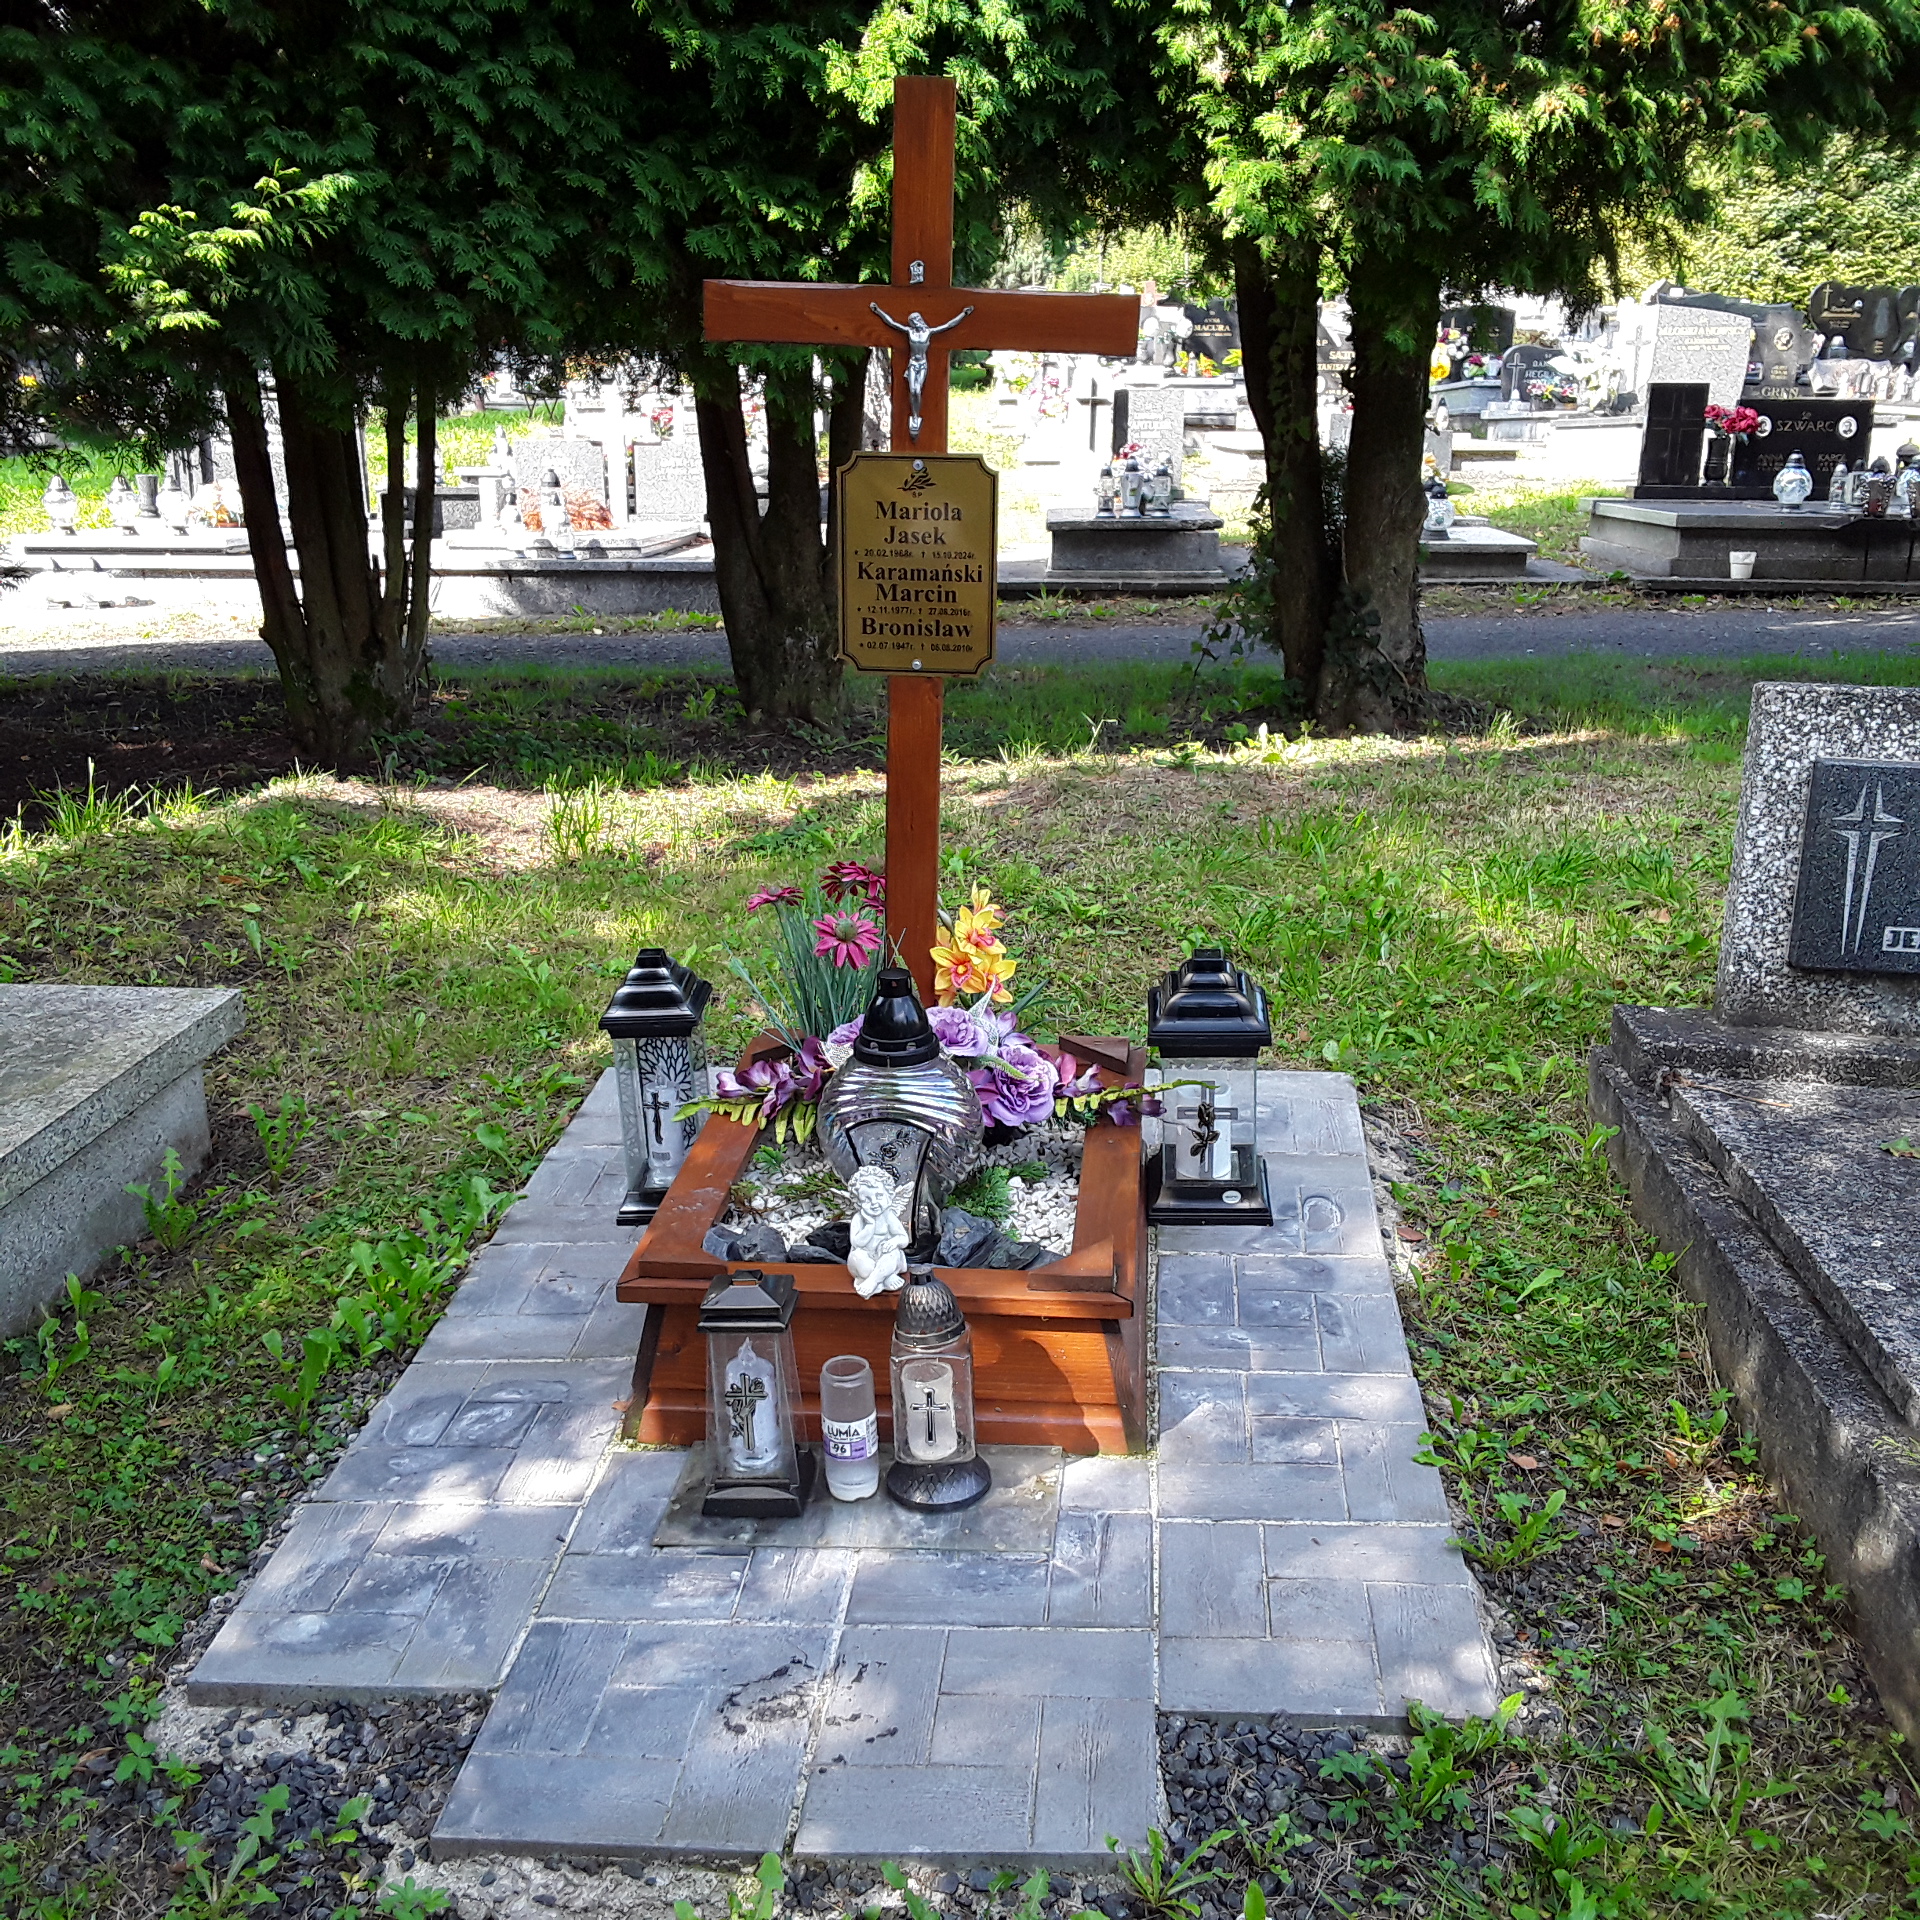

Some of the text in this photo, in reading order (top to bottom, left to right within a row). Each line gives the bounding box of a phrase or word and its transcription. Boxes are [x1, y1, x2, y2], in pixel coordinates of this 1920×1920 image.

[1776, 420, 1834, 432] SZWARC
[876, 500, 962, 521] Mariola
[884, 525, 946, 545] Jasek
[857, 562, 983, 583] Karamański
[876, 583, 957, 603] Marcin
[861, 617, 973, 638] Bronisław
[1886, 930, 1920, 949] JE
